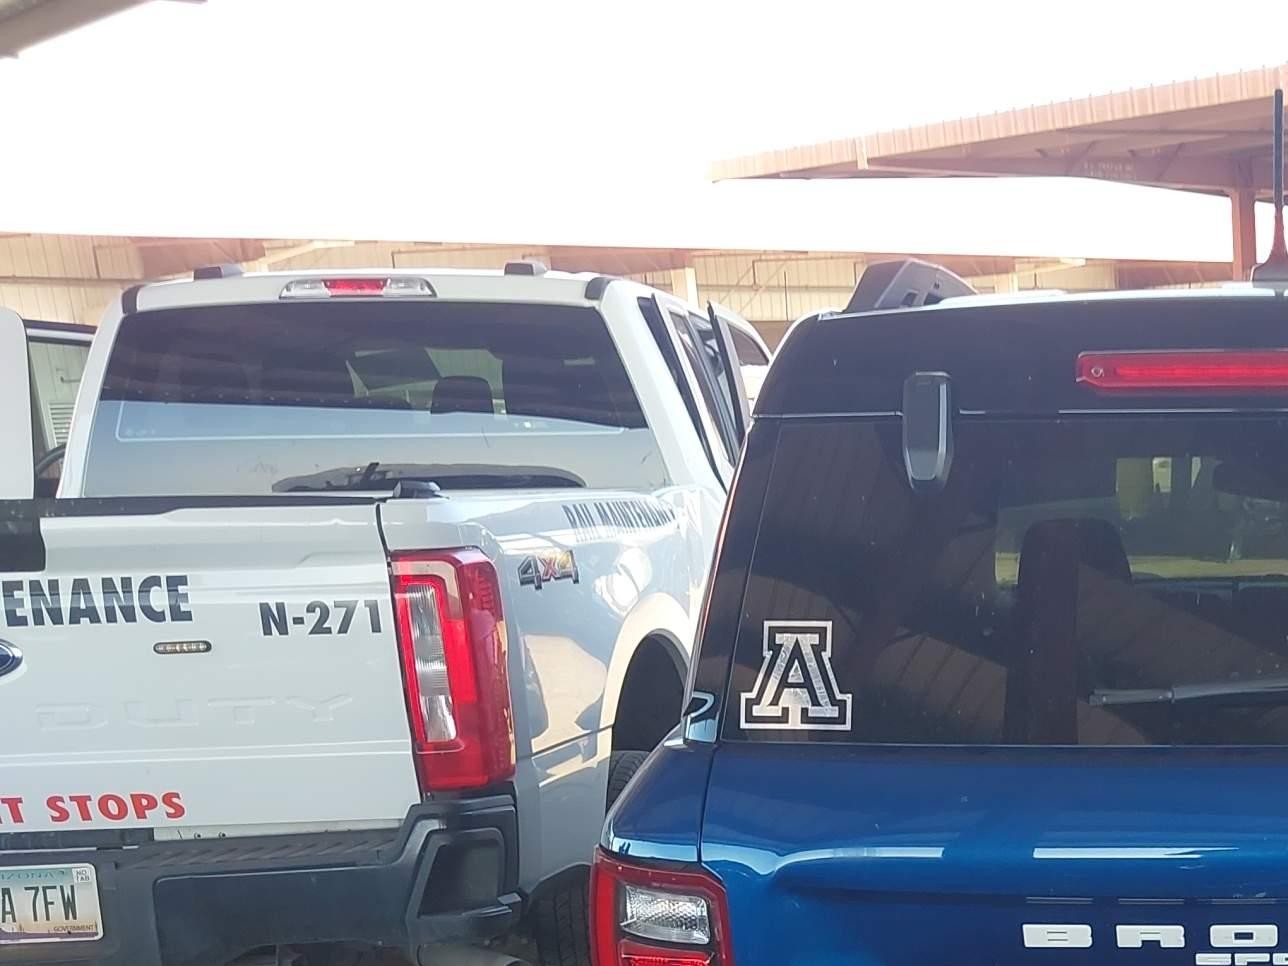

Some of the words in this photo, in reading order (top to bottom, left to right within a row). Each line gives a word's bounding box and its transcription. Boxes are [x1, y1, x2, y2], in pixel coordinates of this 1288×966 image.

[2, 574, 193, 627] ENANCE
[260, 600, 382, 636] N-271
[740, 620, 852, 731] A
[36, 694, 353, 731] DUTY
[46, 792, 186, 823] STOPS
[1, 887, 16, 923] A
[24, 885, 77, 922] 7FW
